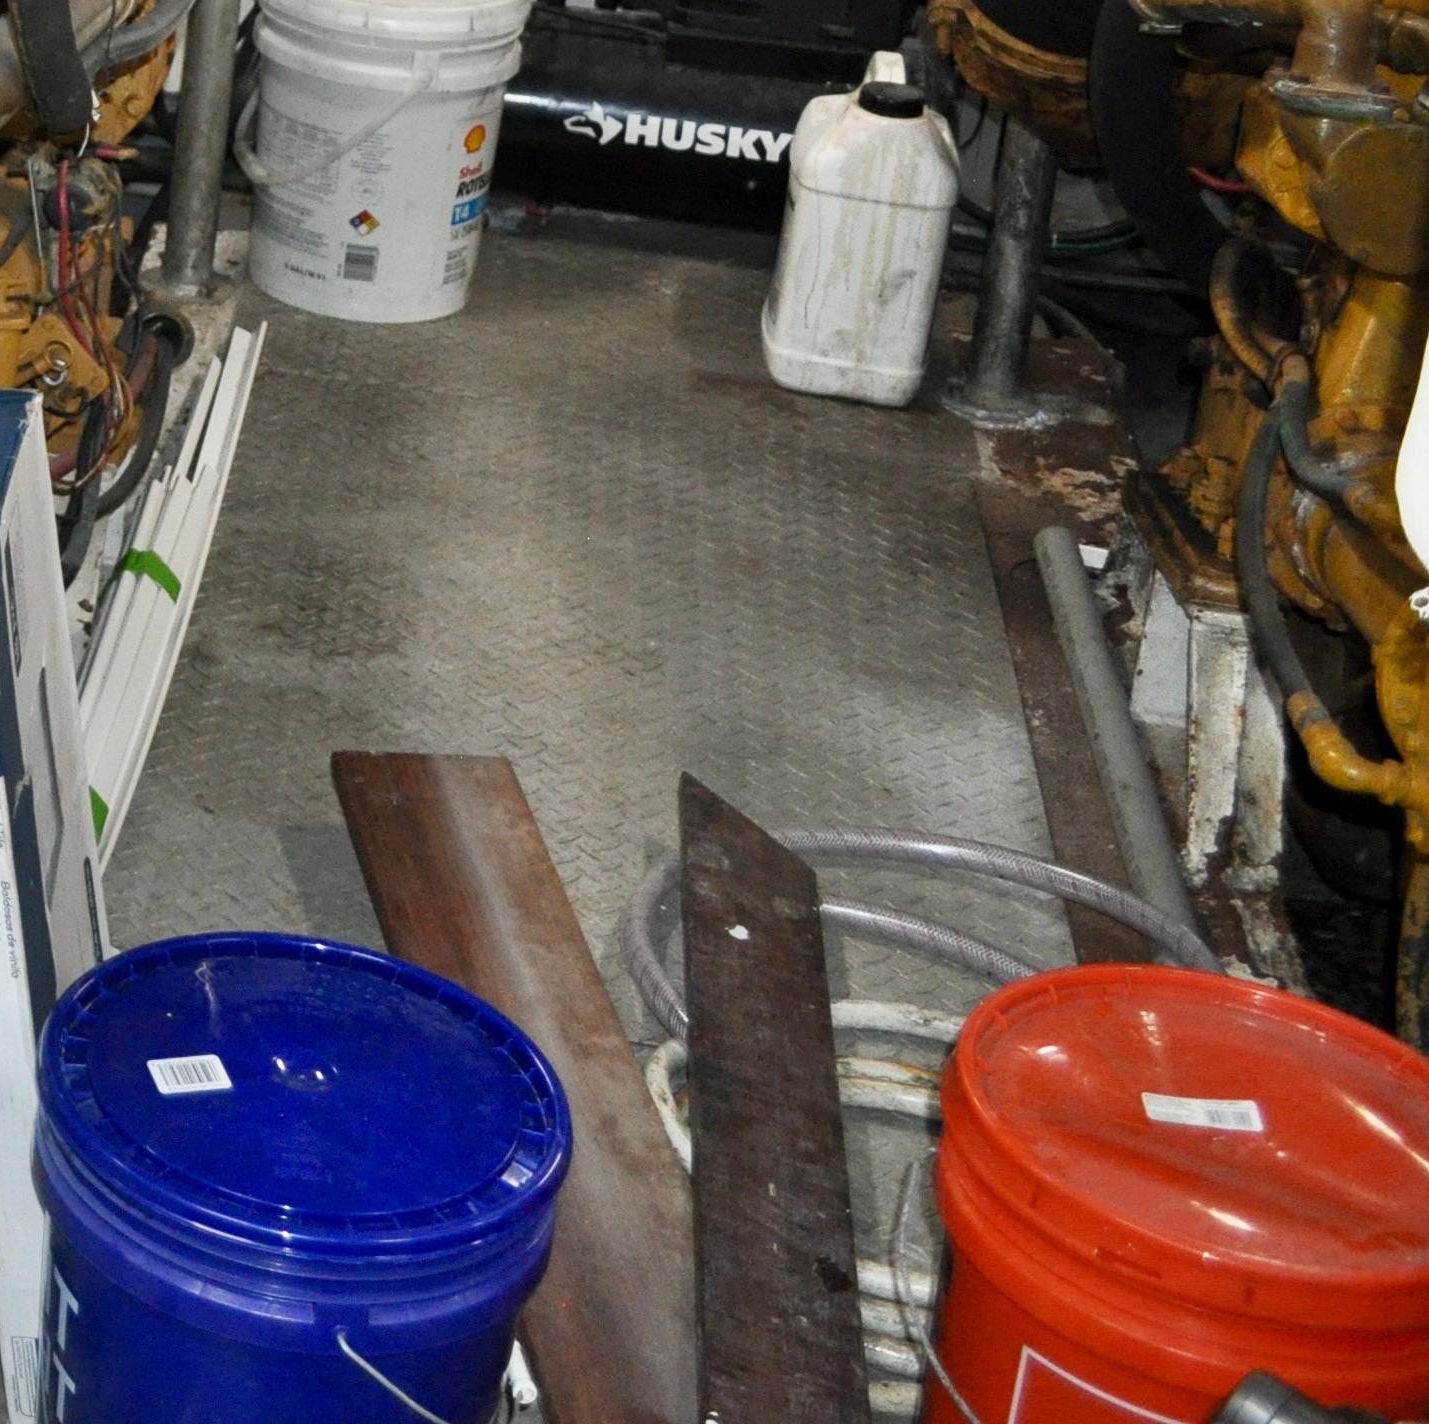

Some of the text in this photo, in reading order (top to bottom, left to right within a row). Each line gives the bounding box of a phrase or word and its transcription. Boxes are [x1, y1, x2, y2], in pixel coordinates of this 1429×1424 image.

[624, 112, 794, 163] HUSKY
[1, 881, 15, 931] Baldosas
[7, 934, 15, 947] de
